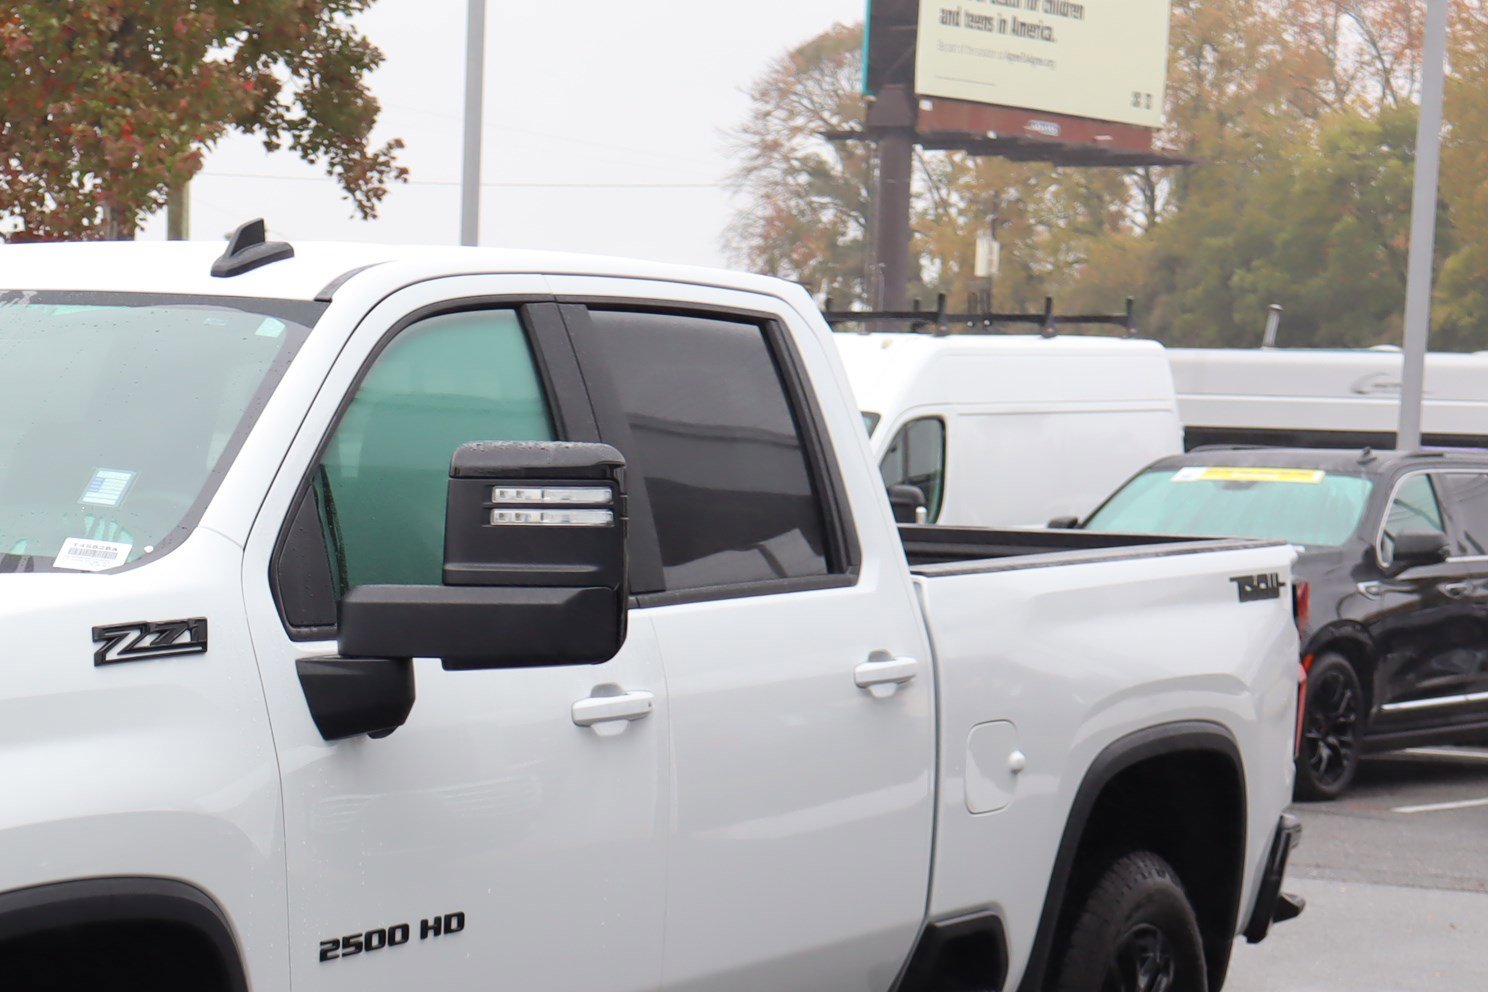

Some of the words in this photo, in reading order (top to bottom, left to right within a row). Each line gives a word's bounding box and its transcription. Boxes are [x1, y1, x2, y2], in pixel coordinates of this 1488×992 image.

[939, 6, 960, 27] and
[963, 11, 994, 33] teens
[997, 13, 1007, 34] in
[1011, 16, 1056, 43] America.
[92, 617, 208, 667] Z71
[319, 923, 409, 962] 2500
[420, 911, 465, 940] HD
